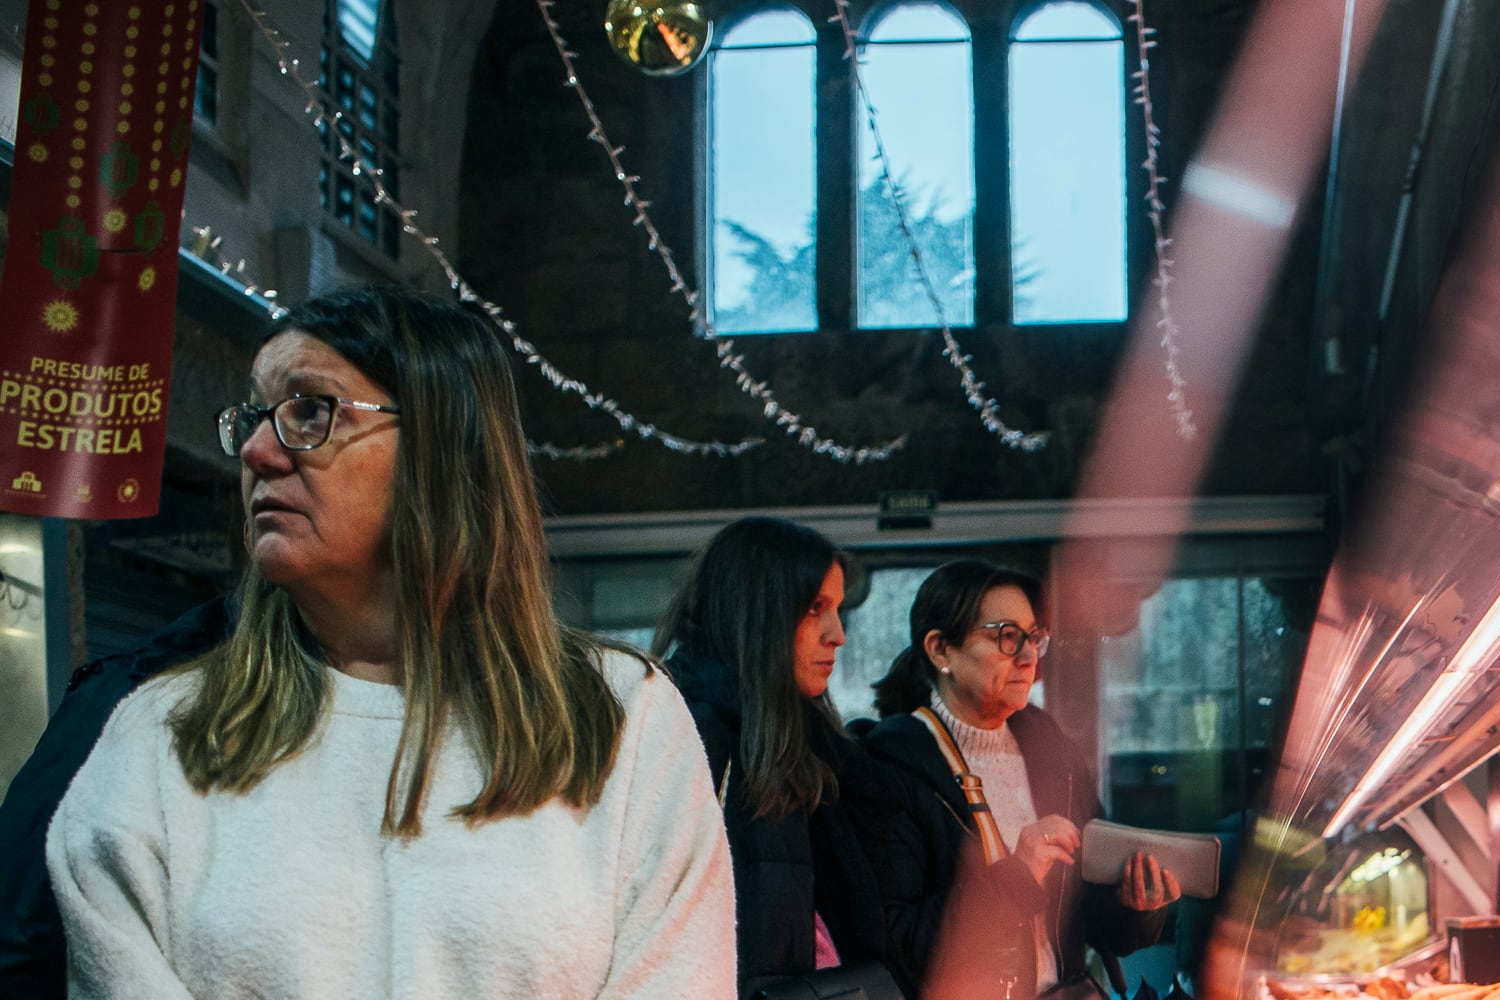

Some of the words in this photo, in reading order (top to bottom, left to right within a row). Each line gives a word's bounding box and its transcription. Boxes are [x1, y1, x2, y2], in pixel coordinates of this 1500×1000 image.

[31, 356, 125, 382] PRESUME
[128, 363, 151, 381] DE
[0, 379, 162, 418] PRODUTOS
[17, 420, 143, 454] ESTRELA
